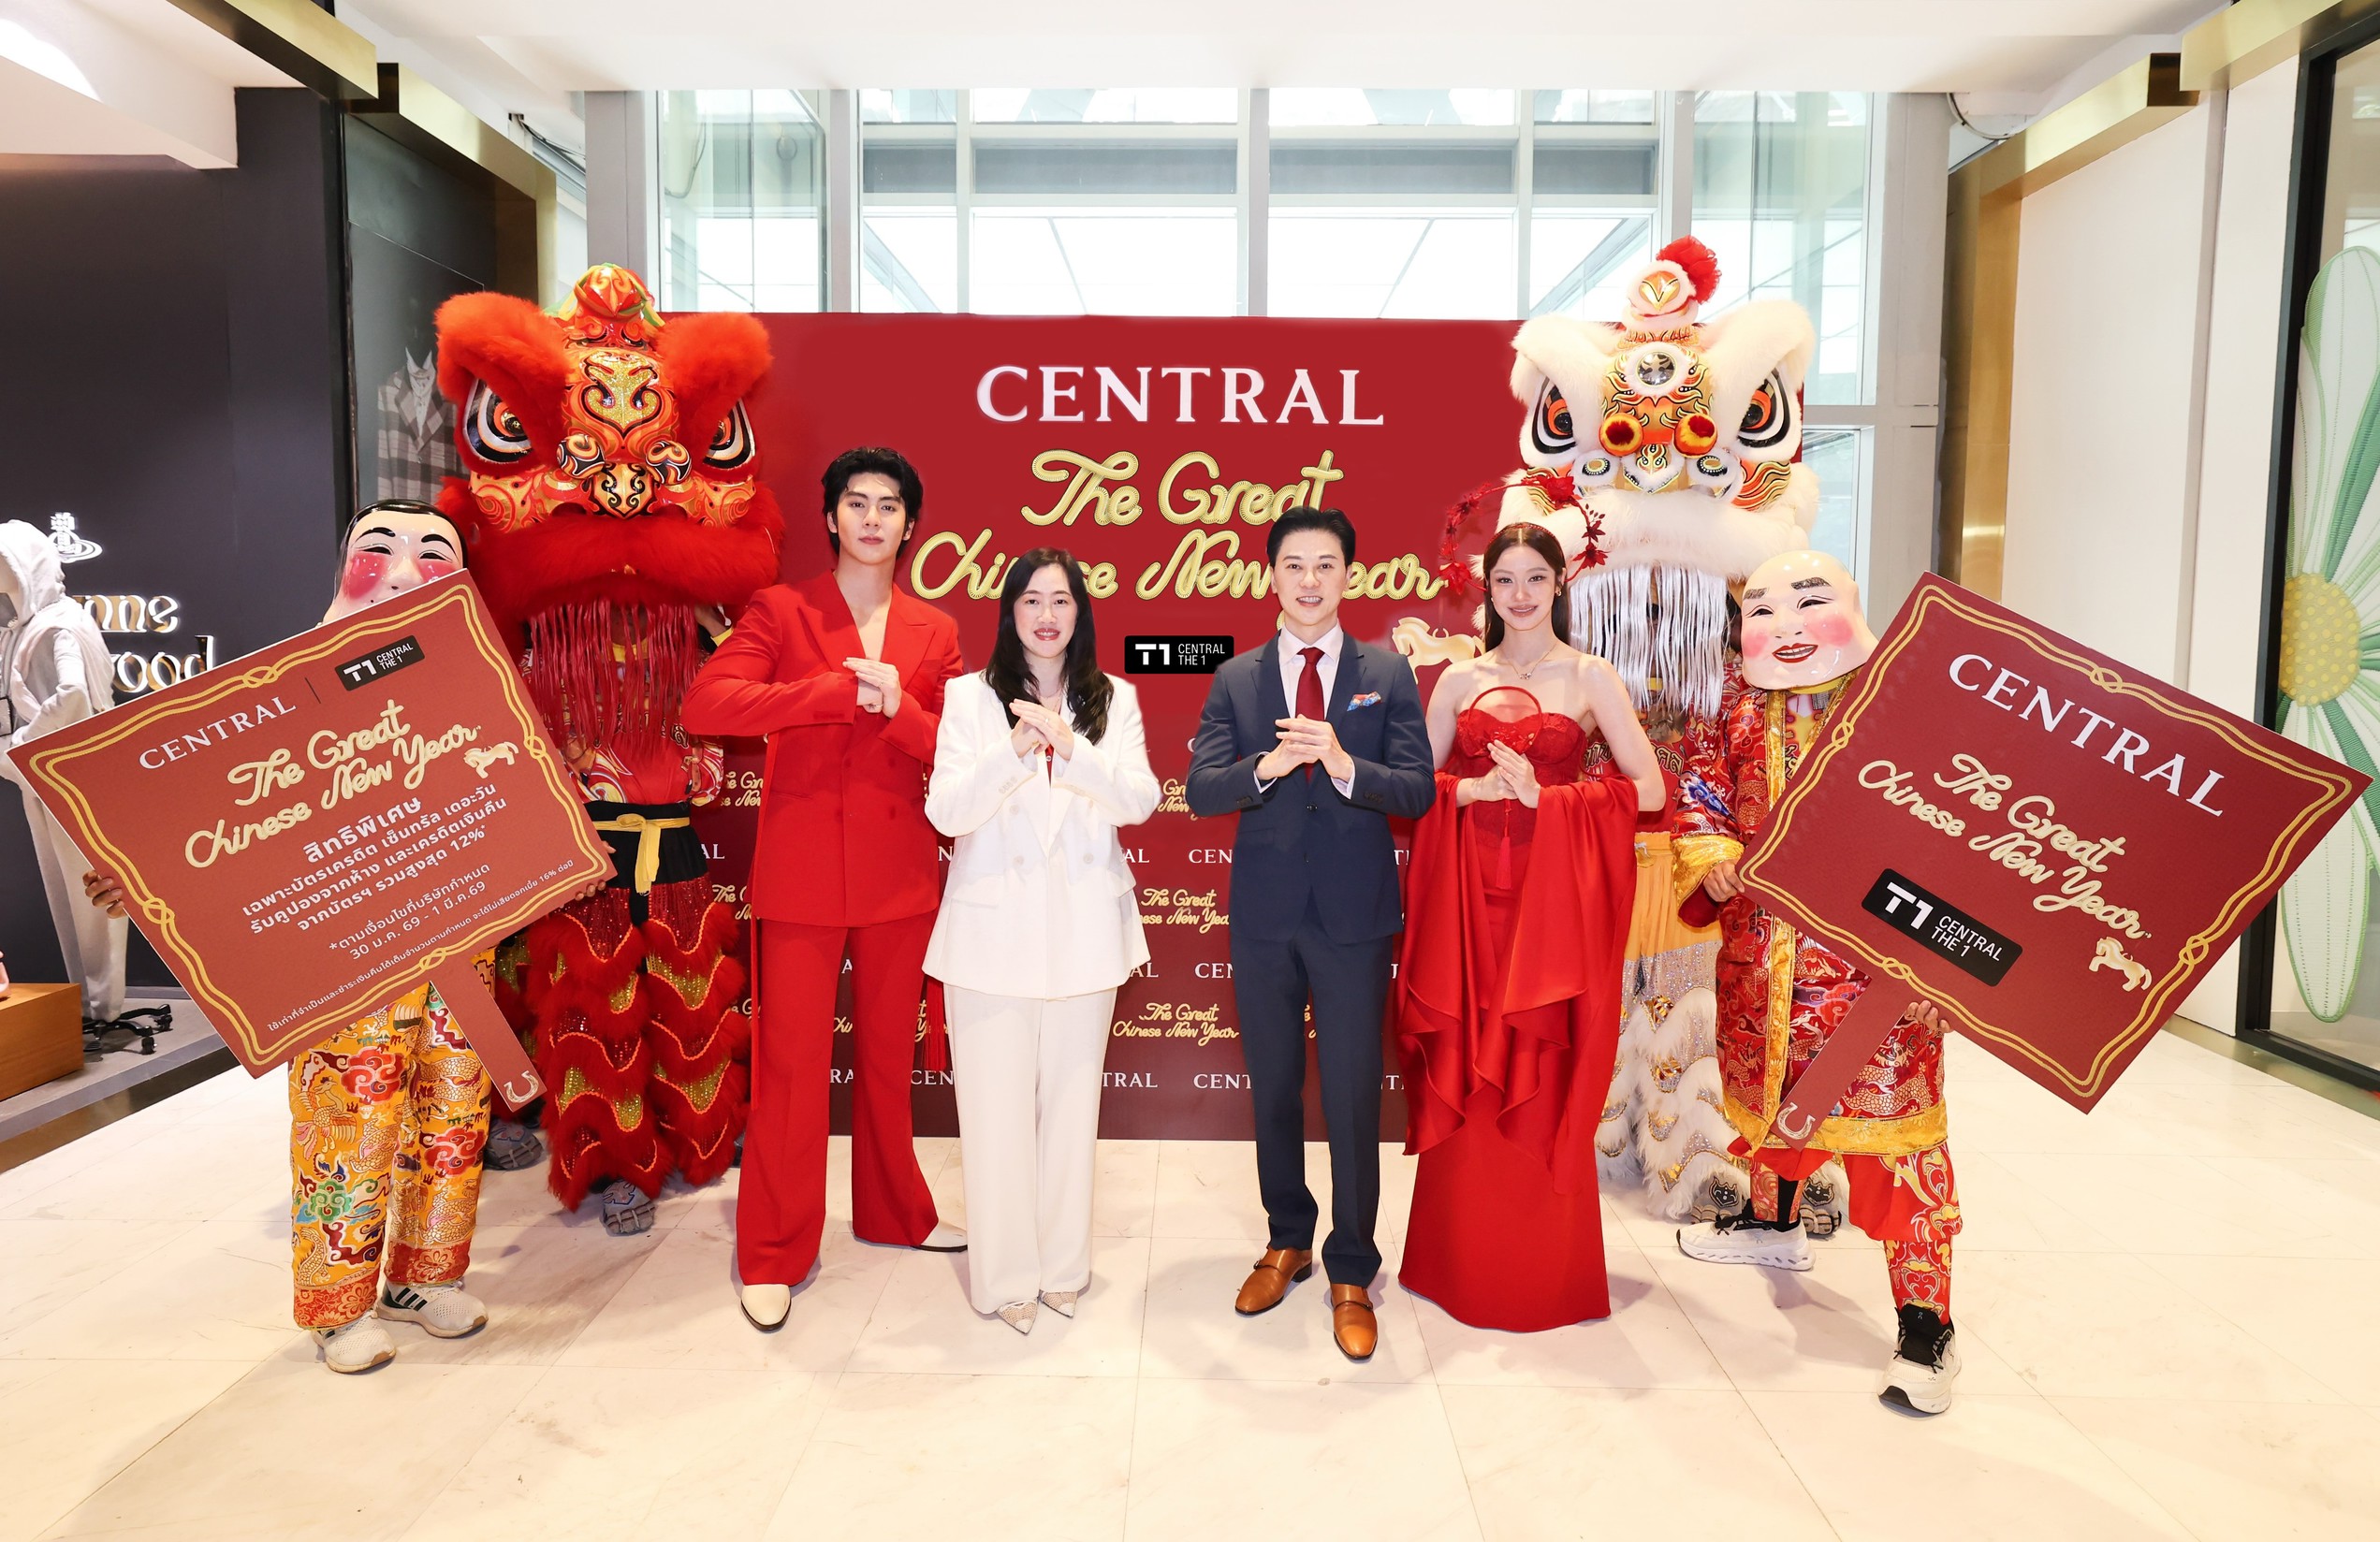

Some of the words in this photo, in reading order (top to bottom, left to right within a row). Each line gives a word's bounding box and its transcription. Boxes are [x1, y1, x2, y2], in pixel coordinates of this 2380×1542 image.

[975, 364, 1384, 426] CENTRAL
[1021, 448, 1143, 527] The
[1158, 449, 1344, 525] Great
[911, 528, 1118, 599] Chie
[1135, 529, 1270, 600] New
[343, 659, 377, 682] T1
[376, 643, 414, 663] CENTRAL
[379, 658, 398, 670] THE
[397, 655, 403, 663] 1
[1135, 644, 1170, 665] T1
[1178, 644, 1225, 654] CENTRAL
[1178, 655, 1198, 665] THE
[1201, 655, 1205, 665] 1
[139, 696, 297, 770] CENTRAL
[226, 748, 306, 806] The
[306, 698, 411, 770] Great
[1949, 653, 2225, 817] CENTRAL
[184, 801, 313, 868] Chinese
[320, 756, 393, 810] New
[392, 723, 479, 791] Year
[1933, 753, 2012, 811] The
[2008, 795, 2126, 872] Great
[241, 843, 378, 917] เฉพาะบัตรเครดิต
[380, 810, 441, 848] เซ็นทรัล
[444, 782, 497, 817] เดอะวัน
[302, 795, 422, 864] สิทธิพิเศษ
[1858, 760, 1965, 837] Chinese
[1968, 832, 2055, 884] New
[2033, 866, 2145, 938] Year
[250, 862, 381, 935] รับคูปองจากห้าง
[384, 795, 507, 868] และเครดิตเงินคืน
[298, 886, 373, 932] จากบัตรฯ
[375, 848, 448, 894] รวมสูงสุด
[539, 869, 557, 882] 16%
[558, 859, 574, 873] ต่อปี
[712, 884, 737, 903] The
[350, 943, 370, 960] 30
[373, 930, 401, 949] ม.ค.
[403, 916, 421, 933] 69
[431, 906, 441, 916] 1
[444, 880, 486, 911] มี.ค.69
[1141, 888, 1170, 907] The
[1173, 888, 1217, 908] Great
[1166, 907, 1200, 925] New
[1199, 907, 1230, 934] Yea
[1885, 881, 1934, 929] T1
[1938, 915, 2004, 962] CENTRAL
[1931, 925, 1961, 952] THE
[1960, 945, 1970, 957] 1
[1113, 1021, 1161, 1038] Chinese
[1165, 1022, 1198, 1038] New
[1198, 1022, 1239, 1046] Year
[1139, 1003, 1172, 1021] The
[1175, 1003, 1219, 1022] Great
[1102, 1072, 1158, 1088] TRAL
[1193, 1073, 1251, 1089] CENT
